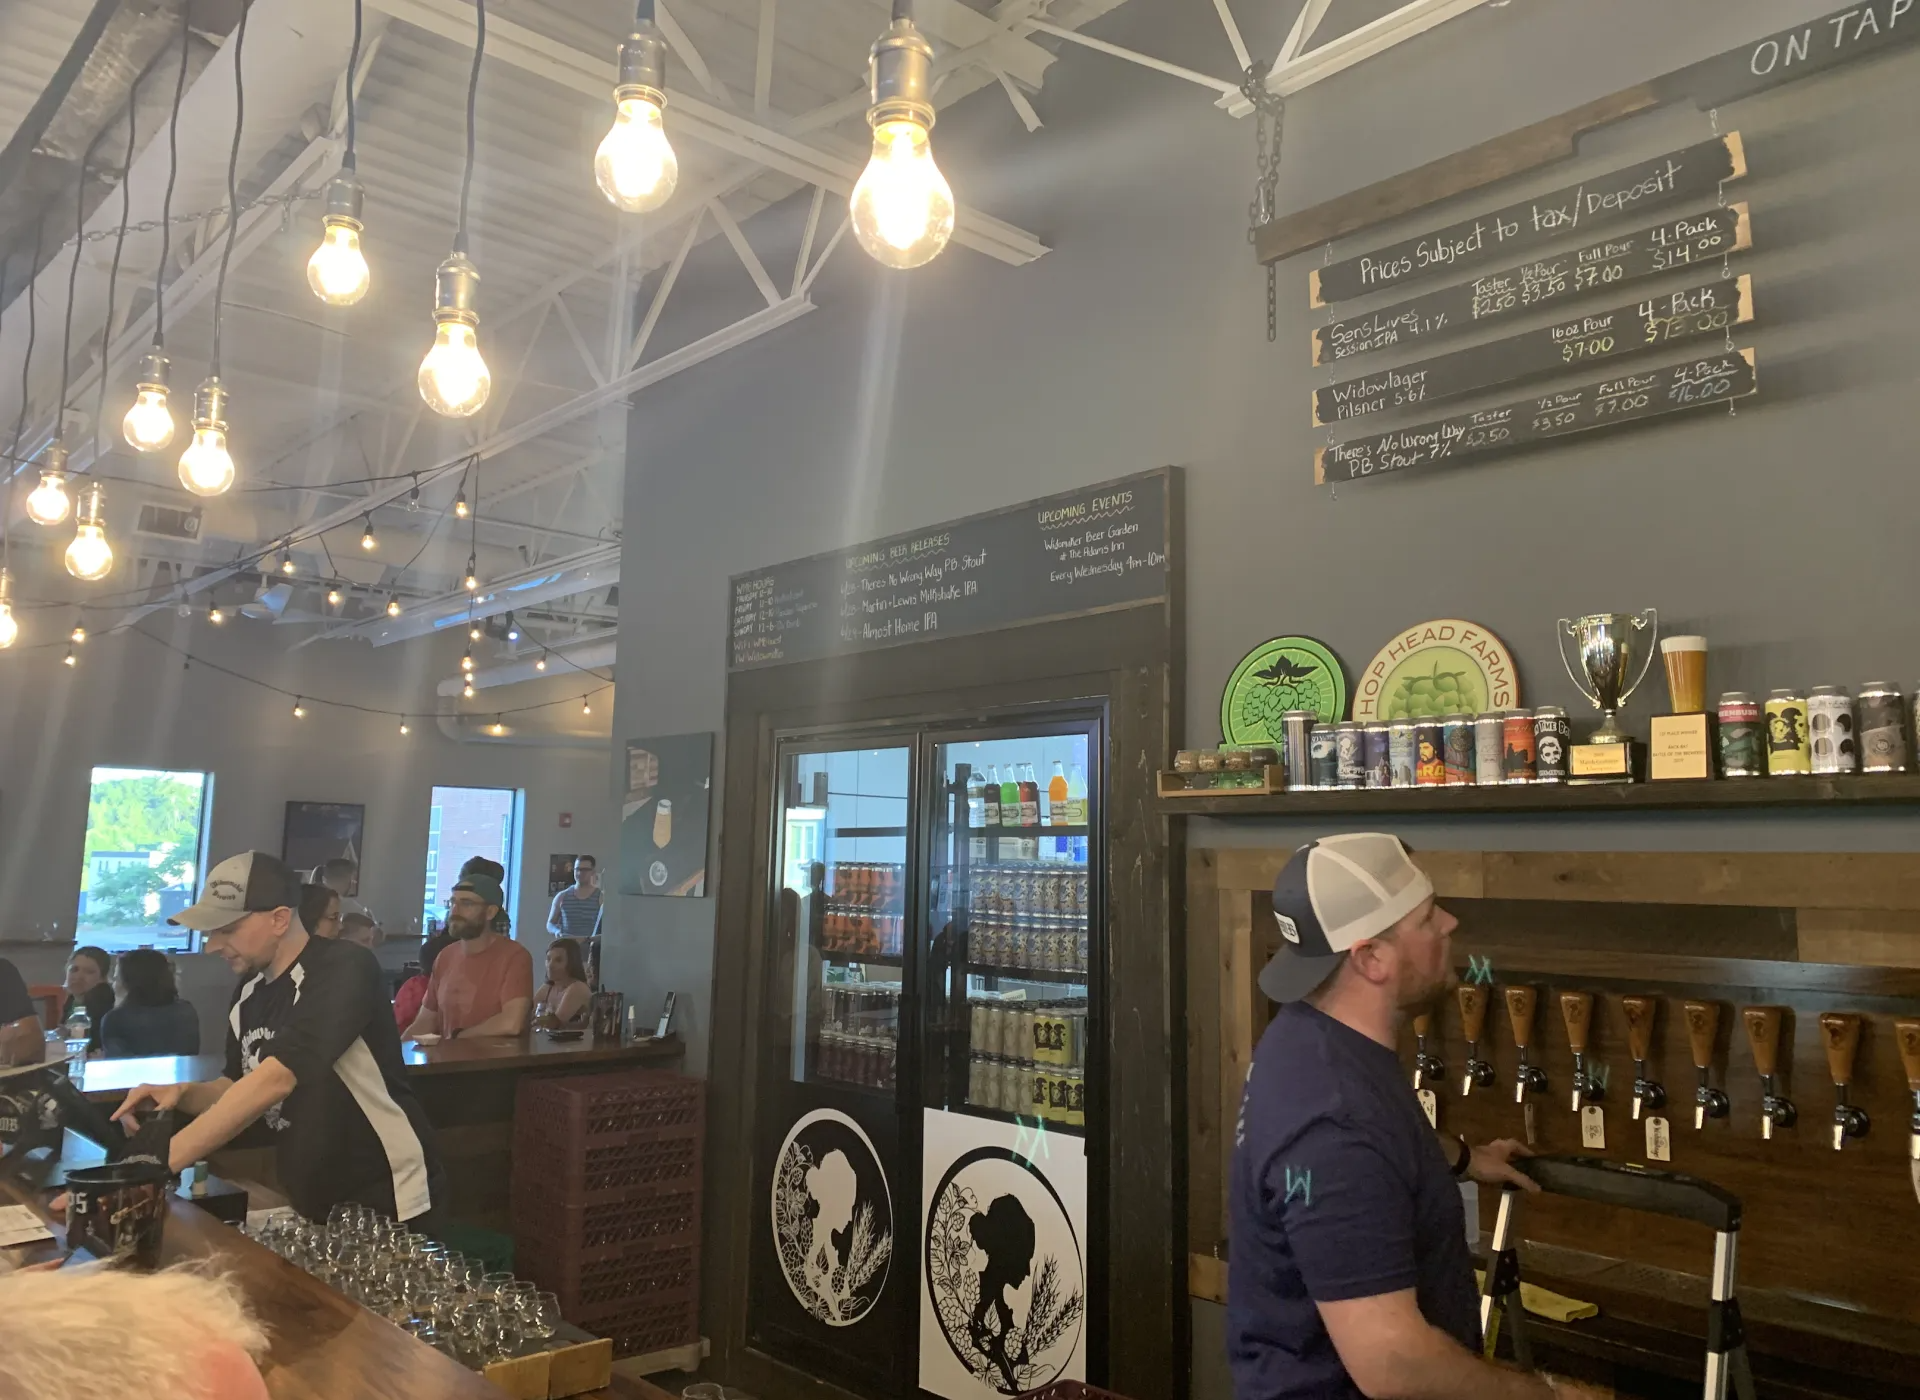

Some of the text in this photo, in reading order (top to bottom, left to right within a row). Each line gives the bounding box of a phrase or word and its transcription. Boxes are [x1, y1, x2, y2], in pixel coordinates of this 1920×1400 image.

[1750, 0, 1914, 75] ON TAP
[1360, 256, 1412, 285] Prices
[1416, 222, 1486, 270] Subject
[1492, 217, 1519, 243] to
[1471, 277, 1512, 296] Taster
[1534, 262, 1560, 277] Pour
[1578, 248, 1602, 262] Full
[1605, 239, 1635, 256] Pour
[1374, 331, 1399, 350] IPA
[1584, 315, 1614, 334] Pour
[1332, 368, 1429, 404] Widowlager
[1470, 407, 1512, 424] Taster
[1555, 391, 1583, 405] Pour
[1599, 379, 1625, 396] Full
[1627, 373, 1657, 390] Pour
[1337, 396, 1386, 420] Pilsner
[1377, 434, 1400, 455] No
[1401, 427, 1440, 452] Wrong
[1441, 422, 1466, 447] Way
[1349, 441, 1452, 479] PB Stout 7%
[1037, 490, 1134, 524] UPCOMING EVENTS
[846, 532, 951, 568] UPCOMING BEER RELEASES
[1070, 549, 1083, 560] The
[1083, 545, 1109, 557] Adams
[1111, 540, 1126, 553] Inn
[1086, 530, 1106, 543] Beer
[1107, 523, 1140, 538] Garden
[888, 574, 898, 587] No
[899, 570, 924, 586] Wrong
[924, 563, 943, 582] Way
[961, 548, 988, 570] Stout
[1050, 570, 1074, 585] Every
[1074, 558, 1124, 578] Wednesday
[920, 584, 962, 604] Milkshake
[963, 580, 978, 596] IPA
[862, 618, 893, 640] Almost
[894, 618, 920, 636] Home
[924, 611, 938, 631] IPA
[1359, 625, 1511, 715] HOP HEAD FARMS
